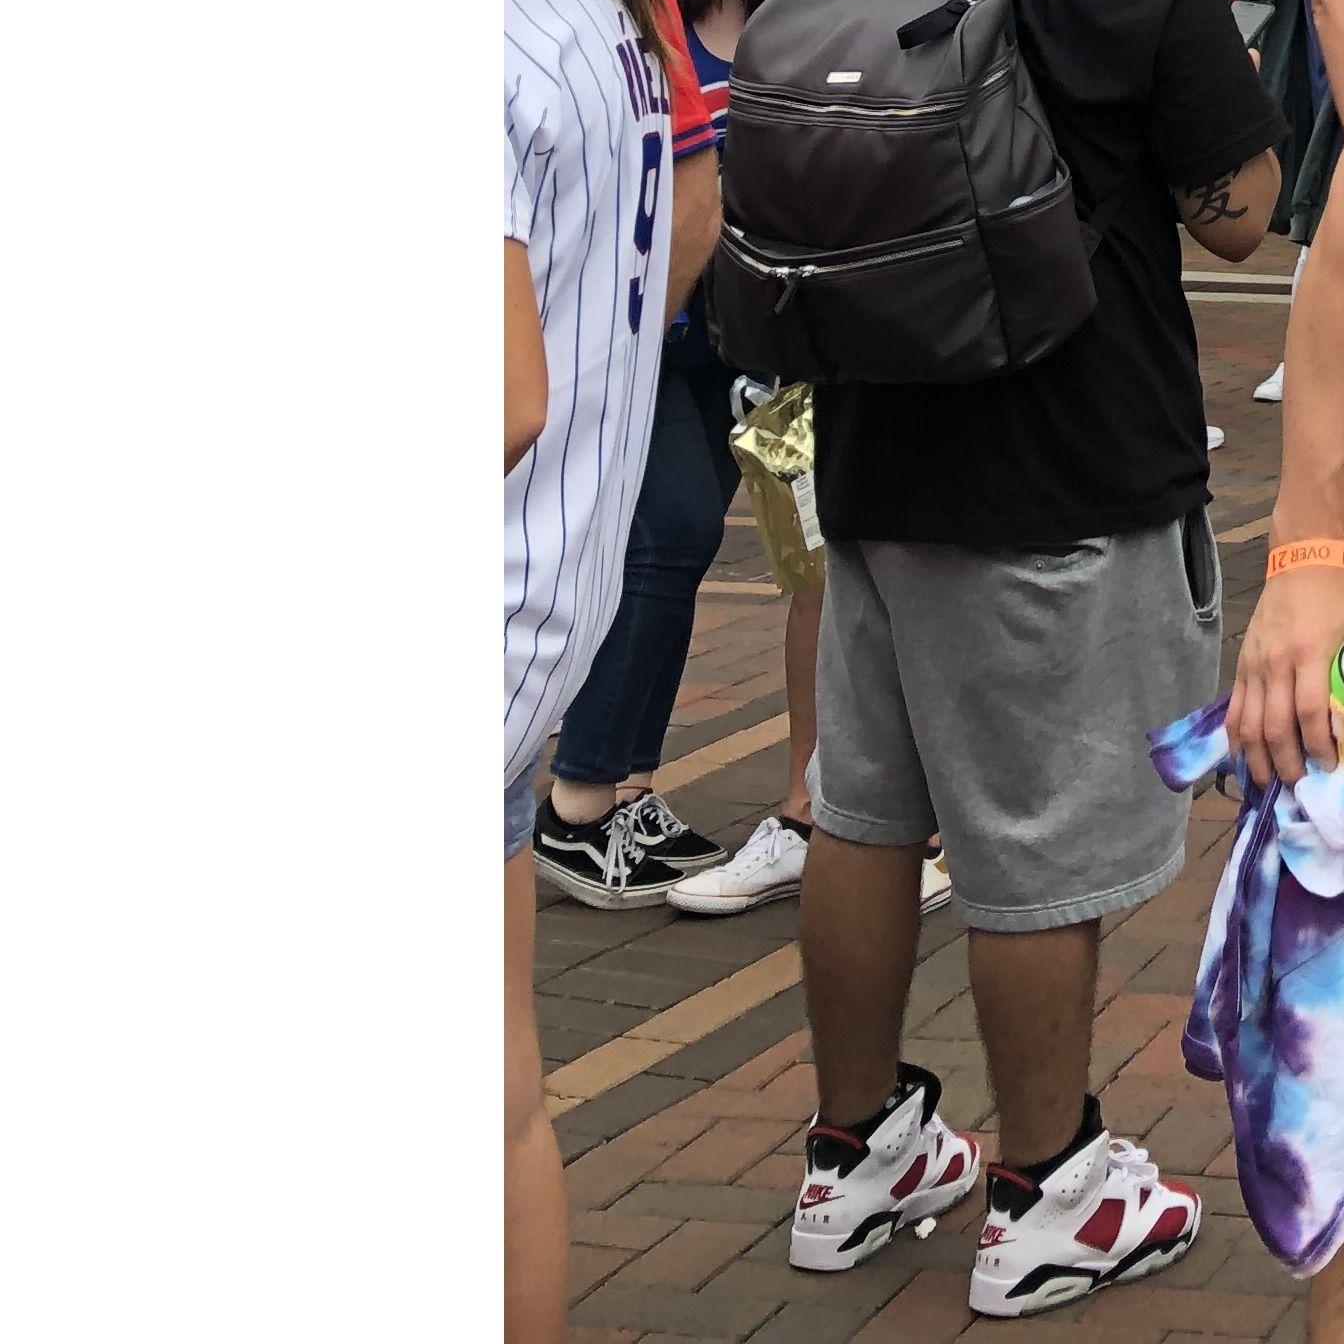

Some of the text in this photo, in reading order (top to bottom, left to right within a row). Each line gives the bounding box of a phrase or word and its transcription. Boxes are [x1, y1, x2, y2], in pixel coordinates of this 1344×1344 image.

[1271, 549, 1288, 573] 21
[1290, 545, 1331, 563] OVER
[806, 1183, 834, 1201] NIKE
[800, 1212, 830, 1224] AIR
